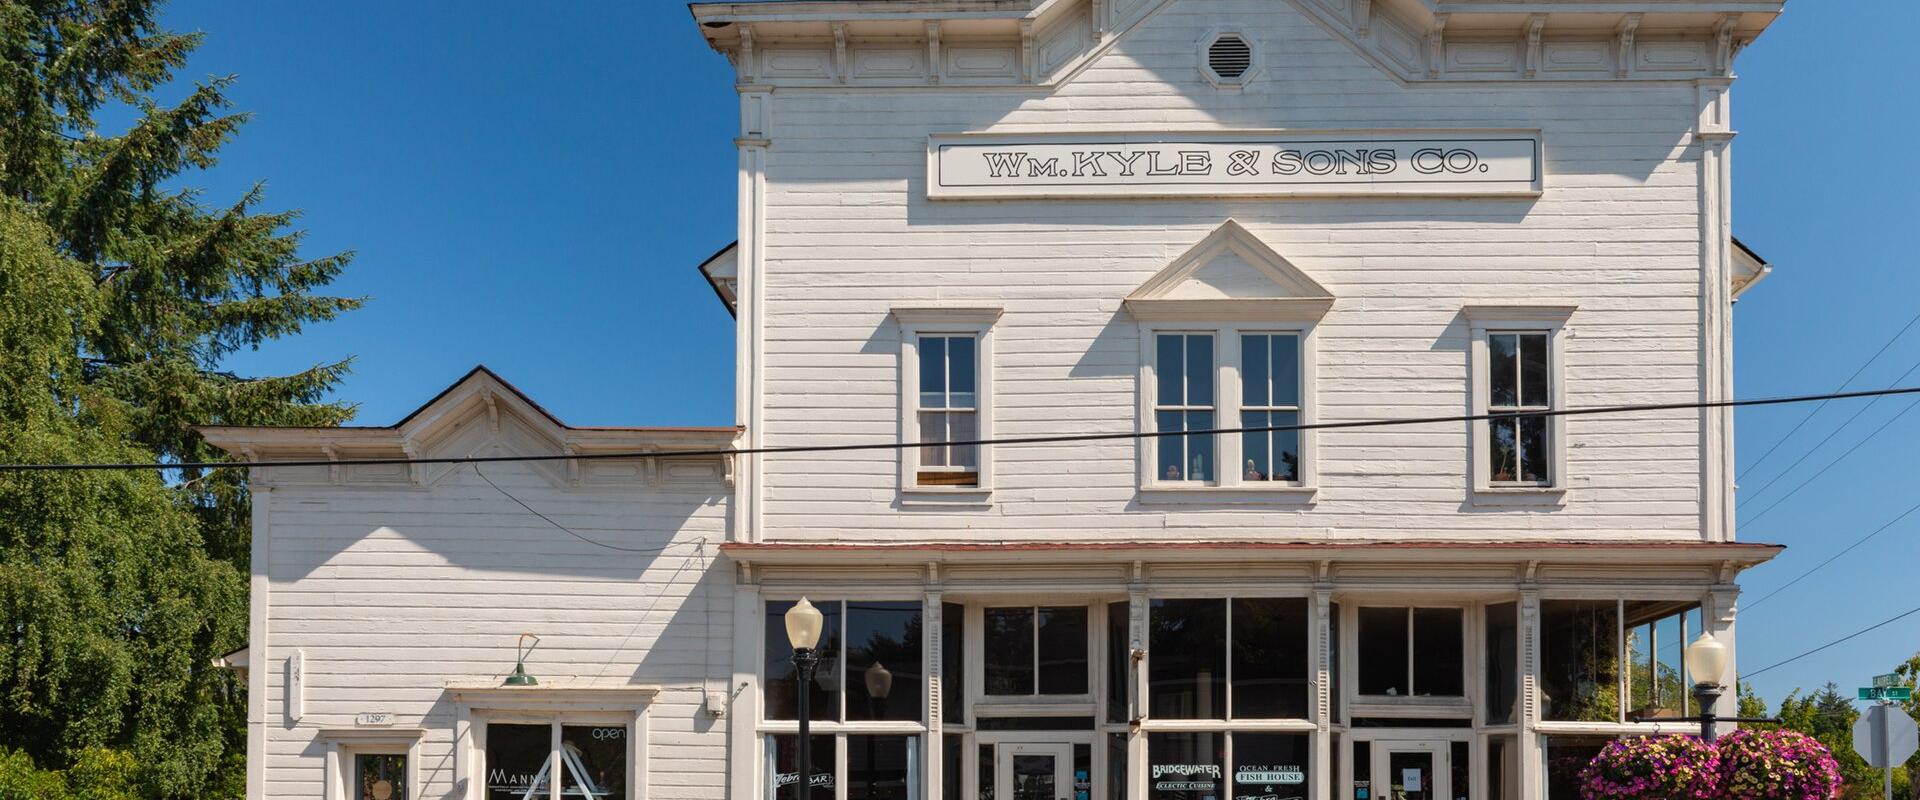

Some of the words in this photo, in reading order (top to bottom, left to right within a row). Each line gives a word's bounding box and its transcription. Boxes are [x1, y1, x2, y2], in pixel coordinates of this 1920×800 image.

[1071, 150, 1213, 177] KYLE
[1226, 150, 1260, 176] &
[1272, 149, 1398, 175] SONS
[1410, 148, 1489, 175] CO.
[1870, 688, 1889, 698] BAY
[366, 714, 385, 723] 1297
[592, 728, 626, 741] open
[489, 768, 546, 784] MANN
[1152, 764, 1222, 779] BRIDGEWATER
[1240, 773, 1262, 781] FISH
[1267, 773, 1301, 781] HOUSE
